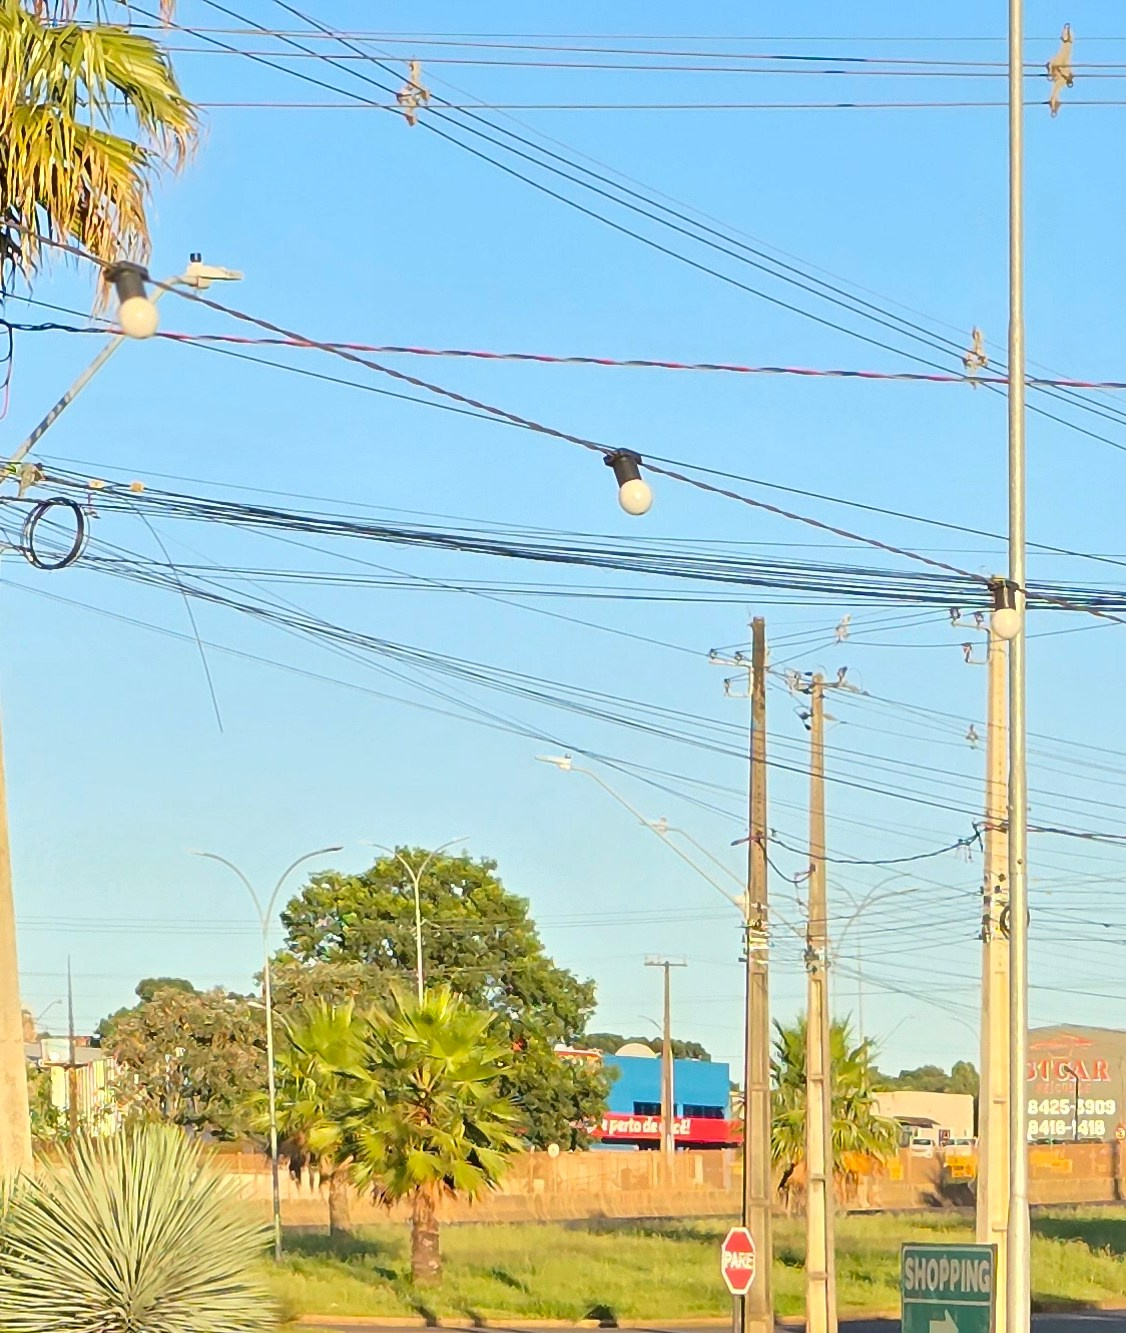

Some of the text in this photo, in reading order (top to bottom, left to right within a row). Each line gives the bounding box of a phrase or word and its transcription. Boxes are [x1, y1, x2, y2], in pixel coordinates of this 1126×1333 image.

[643, 1115, 658, 1133] de
[724, 1251, 754, 1269] PARE
[905, 1256, 990, 1293] SHOPPING
